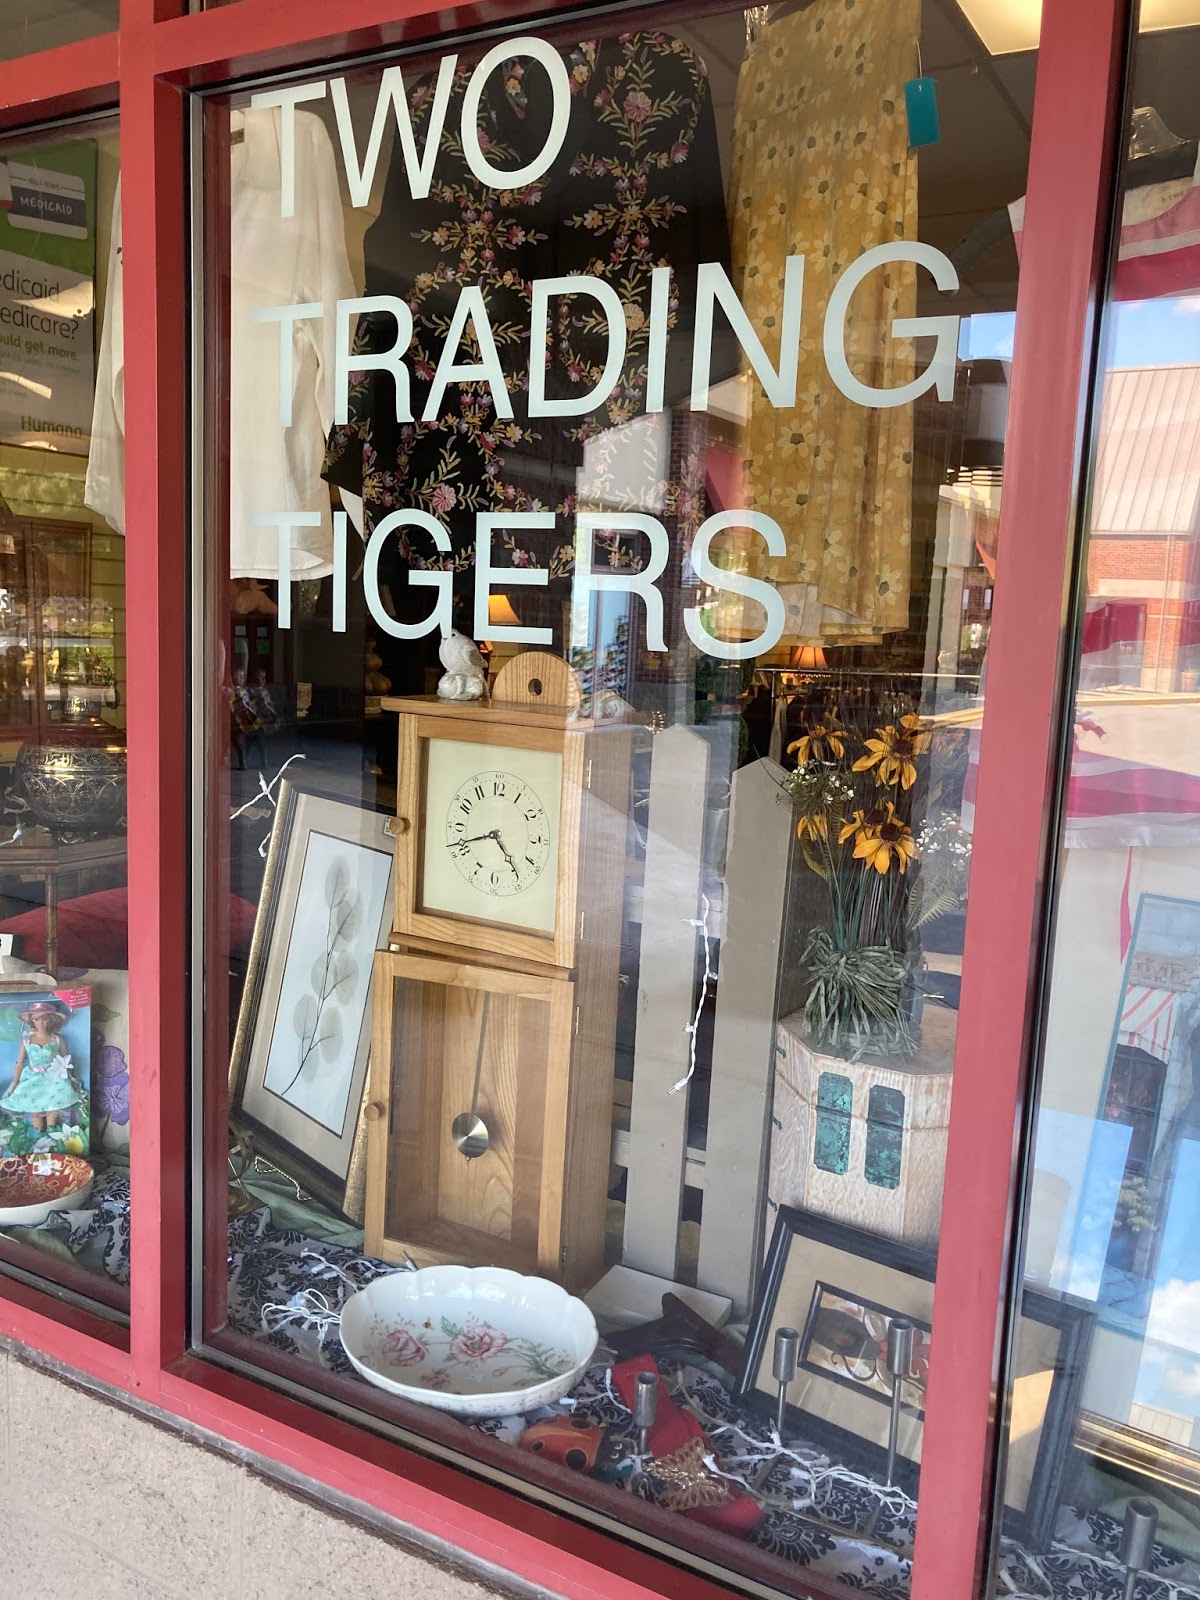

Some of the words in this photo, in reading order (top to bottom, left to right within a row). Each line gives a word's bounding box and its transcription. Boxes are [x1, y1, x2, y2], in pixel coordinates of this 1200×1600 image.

[250, 37, 572, 217] TWO
[20, 196, 73, 215] MEDICAID
[0, 269, 60, 303] dicaid
[252, 240, 962, 428] TRADING
[25, 339, 48, 354] get
[48, 346, 80, 361] more.
[21, 415, 82, 439] Humana
[251, 509, 787, 659] TIGERS
[474, 785, 485, 800] 11
[493, 782, 506, 797] 12
[514, 793, 521, 803] 1
[460, 798, 473, 815] 10
[524, 809, 537, 821] 2
[529, 833, 541, 844] 3
[459, 845, 470, 856] 8
[473, 862, 483, 875] 7
[525, 855, 535, 869] 4
[490, 871, 499, 885] 6
